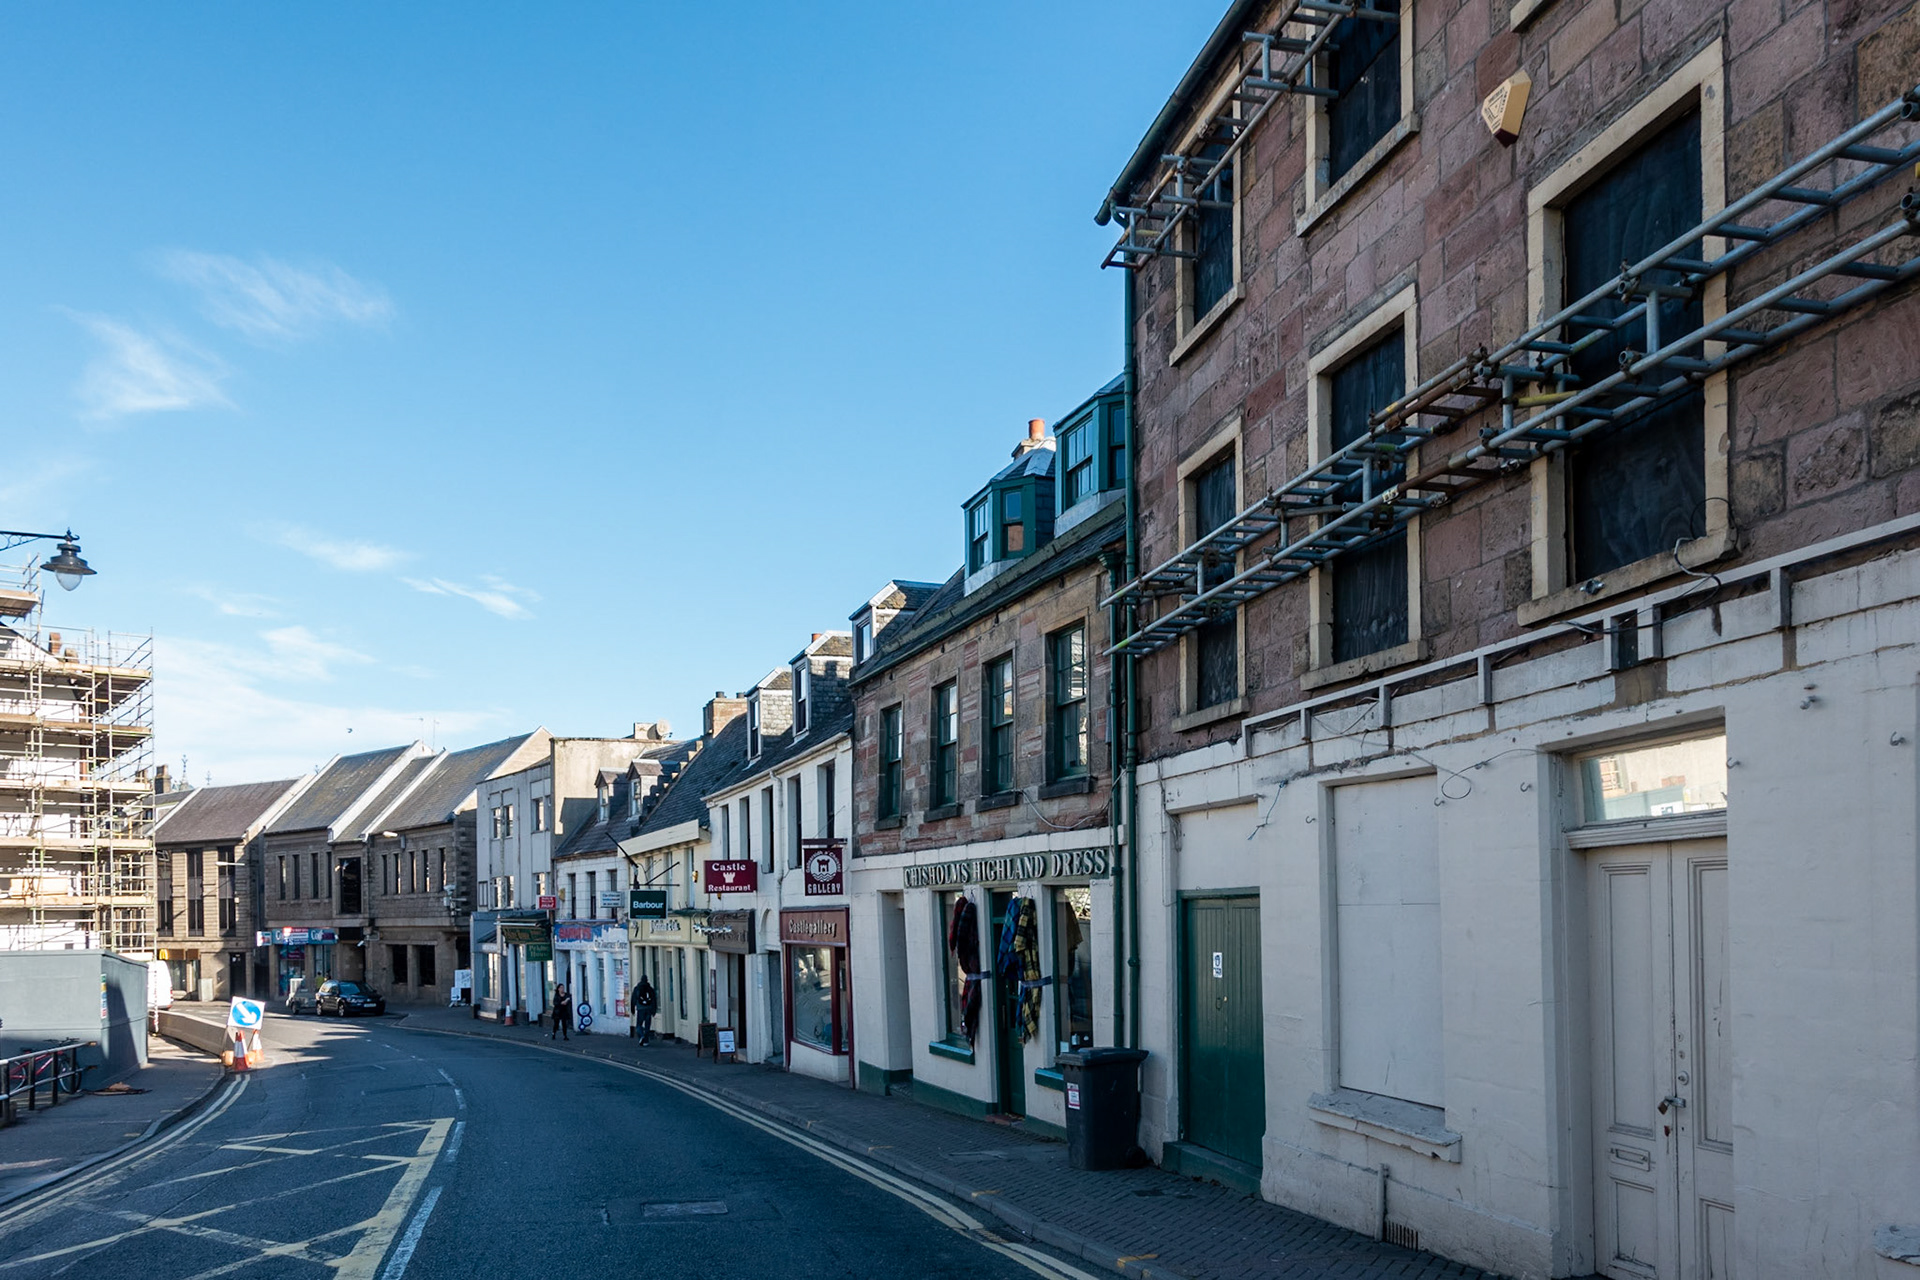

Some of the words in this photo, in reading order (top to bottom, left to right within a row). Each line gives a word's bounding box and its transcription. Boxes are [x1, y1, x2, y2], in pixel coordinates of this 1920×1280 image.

[712, 862, 746, 871] Castle
[904, 862, 970, 887] CHISHOLMS
[973, 855, 1046, 881] HIGHLAND
[1051, 849, 1107, 877] DRESS
[708, 884, 751, 892] Restaurant
[807, 883, 841, 894] GALLERY
[632, 901, 664, 909] Barbour
[788, 919, 837, 938] Castlegallery
